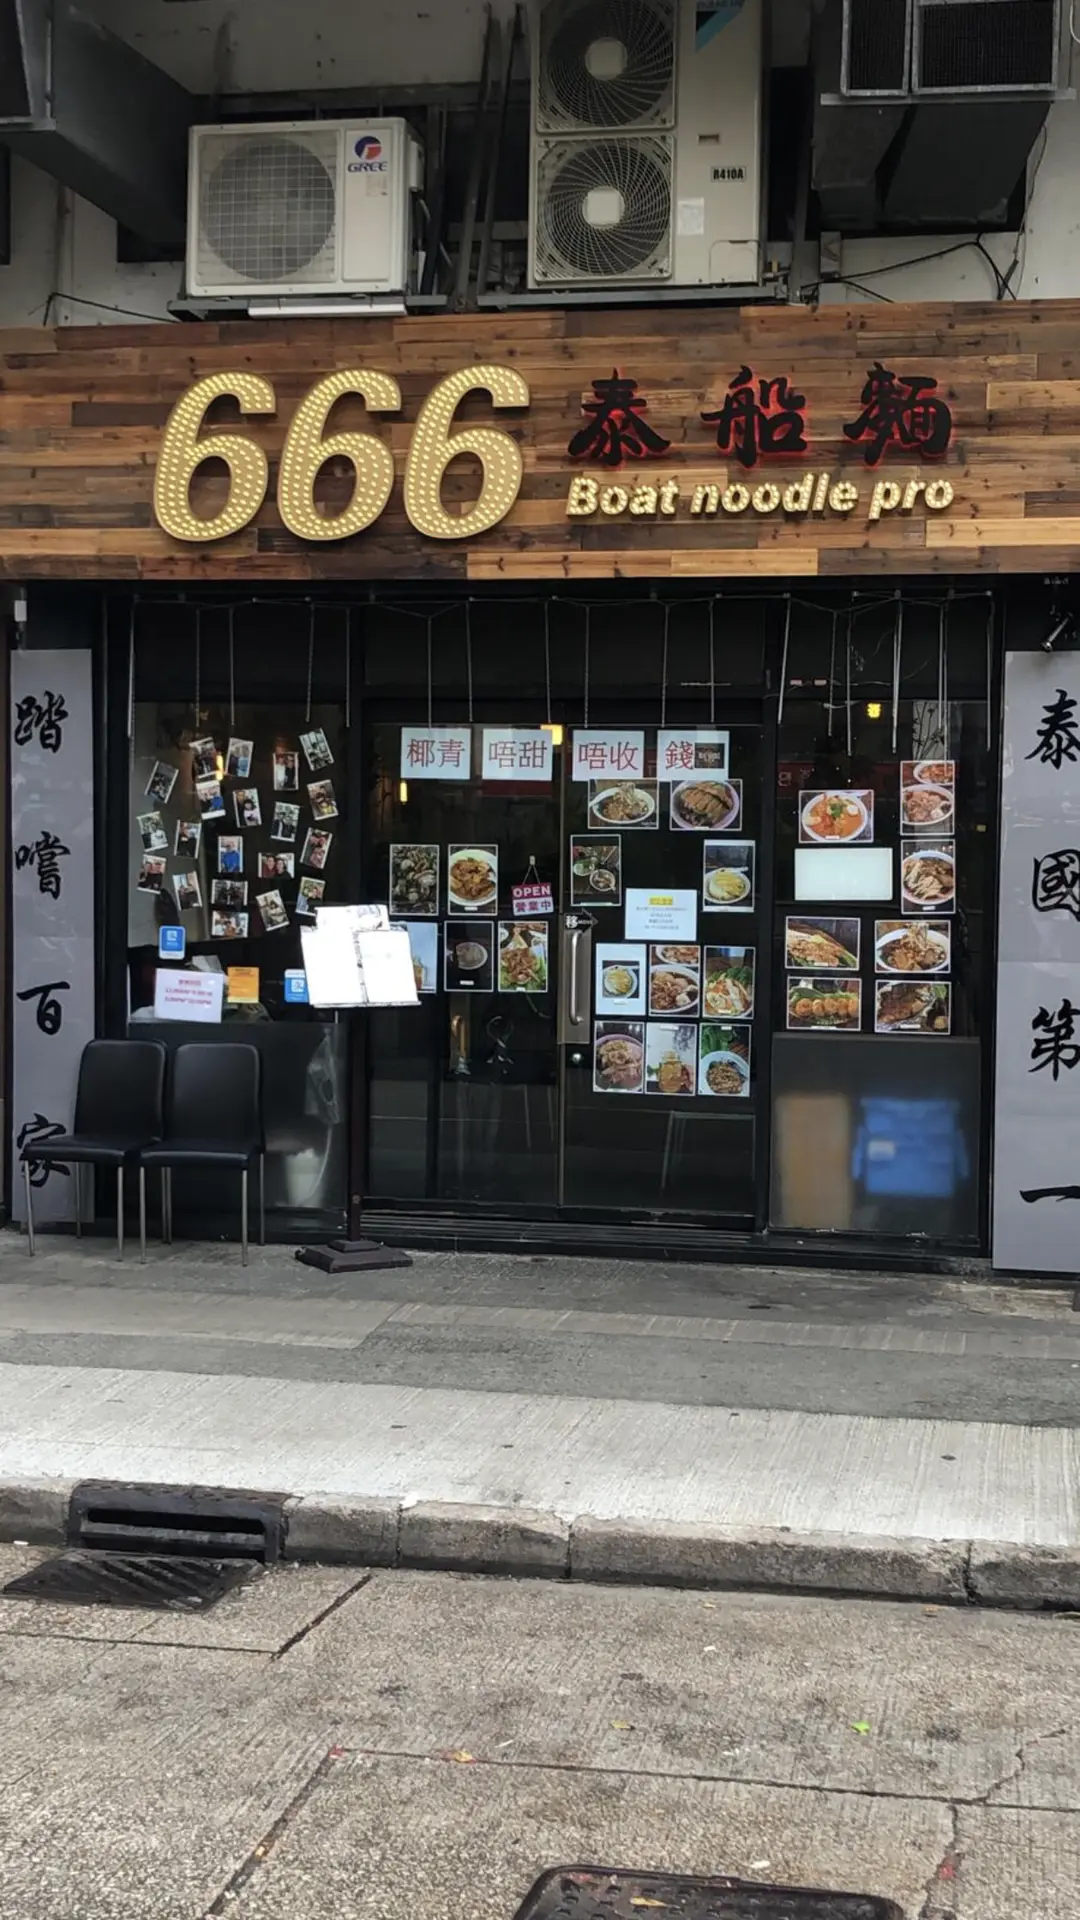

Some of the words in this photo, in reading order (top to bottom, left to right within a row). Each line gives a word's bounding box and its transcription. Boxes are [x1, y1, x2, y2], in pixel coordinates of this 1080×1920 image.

[347, 162, 388, 172] GREE
[567, 361, 952, 468] 泰船麵
[153, 364, 530, 542] 666
[566, 475, 678, 517] Boat
[690, 472, 859, 513] noodle
[867, 477, 954, 520] pro
[406, 738, 466, 768] 椰青
[488, 740, 548, 769] 唔甜
[578, 741, 639, 771] 唔收
[664, 741, 694, 771] 錢
[513, 886, 551, 898] OPEN
[515, 899, 551, 913] 營業中
